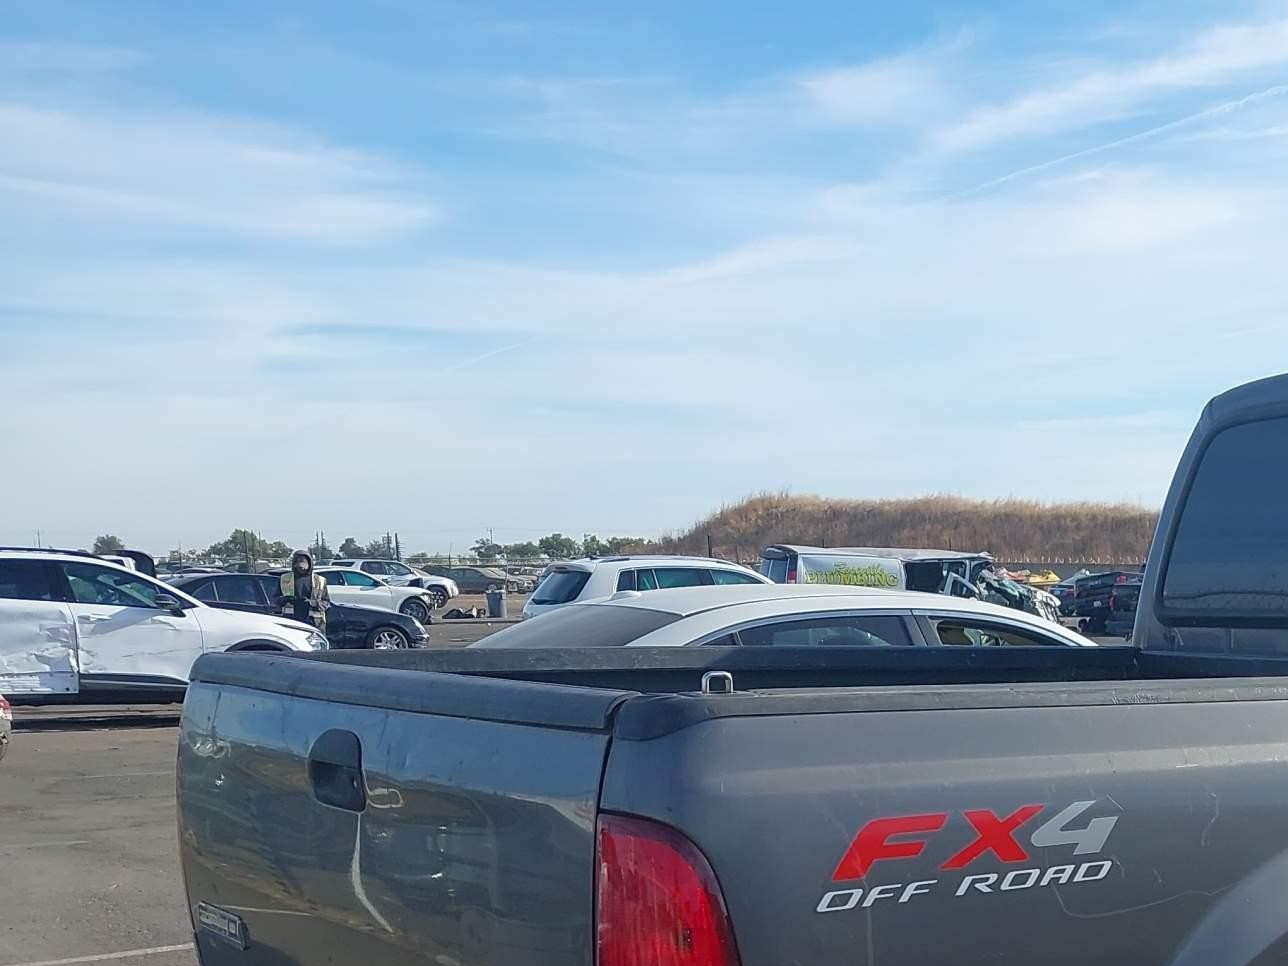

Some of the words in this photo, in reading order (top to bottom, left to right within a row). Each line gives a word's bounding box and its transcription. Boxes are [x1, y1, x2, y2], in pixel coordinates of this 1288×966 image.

[806, 570, 898, 586] PLUMBING
[832, 800, 1119, 882] FX4
[816, 879, 938, 913] OFF
[955, 860, 1112, 896] ROAD
